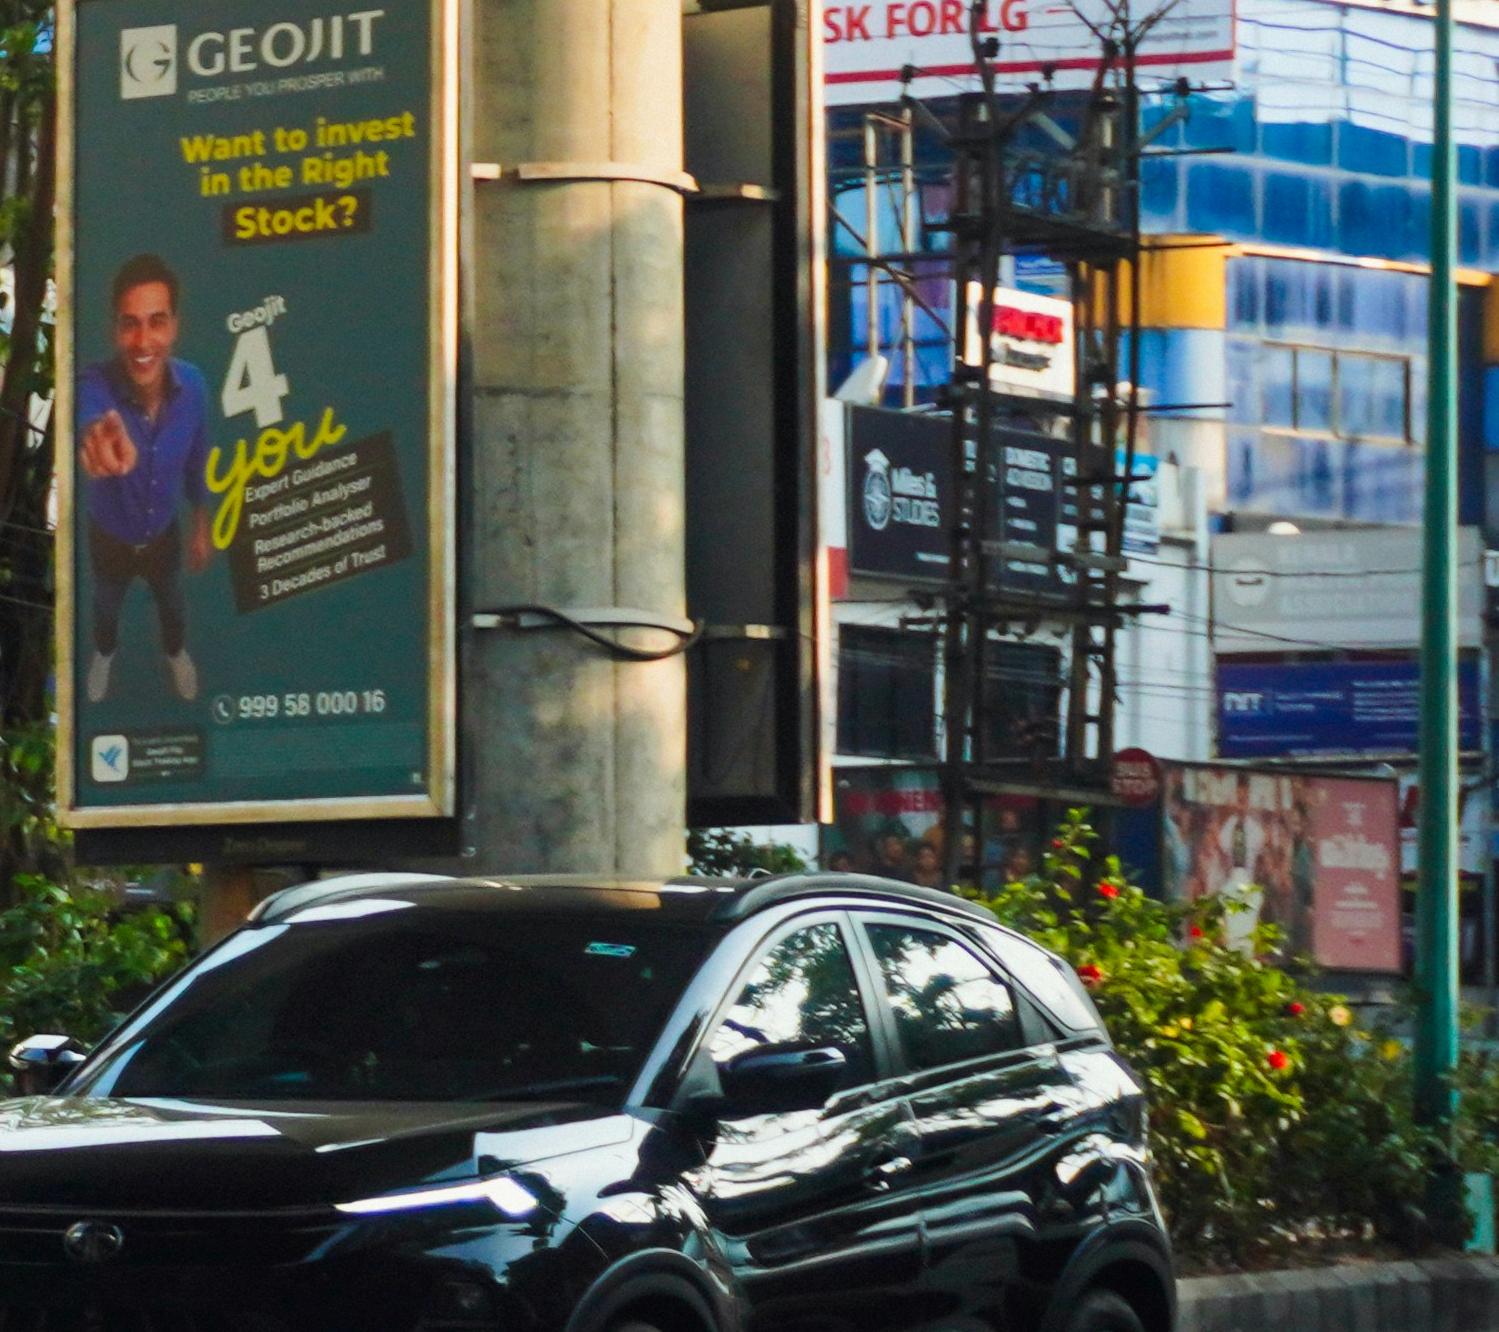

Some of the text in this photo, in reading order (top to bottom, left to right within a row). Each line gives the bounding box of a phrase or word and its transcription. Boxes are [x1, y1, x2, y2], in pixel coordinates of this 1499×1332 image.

[187, 9, 385, 77] GEOJIT
[823, 4, 873, 44] SK
[187, 83, 243, 103] PEOPLE
[244, 80, 276, 97] YOU
[277, 71, 346, 93] PROSPER
[180, 111, 415, 164] Want to invest
[200, 150, 389, 197] in the Right
[235, 195, 359, 240] Stock?
[226, 294, 287, 333] Geojit
[221, 325, 290, 429] 4
[205, 406, 348, 551] you
[244, 475, 290, 503] Expert
[238, 689, 386, 719] 999 58 000 16
